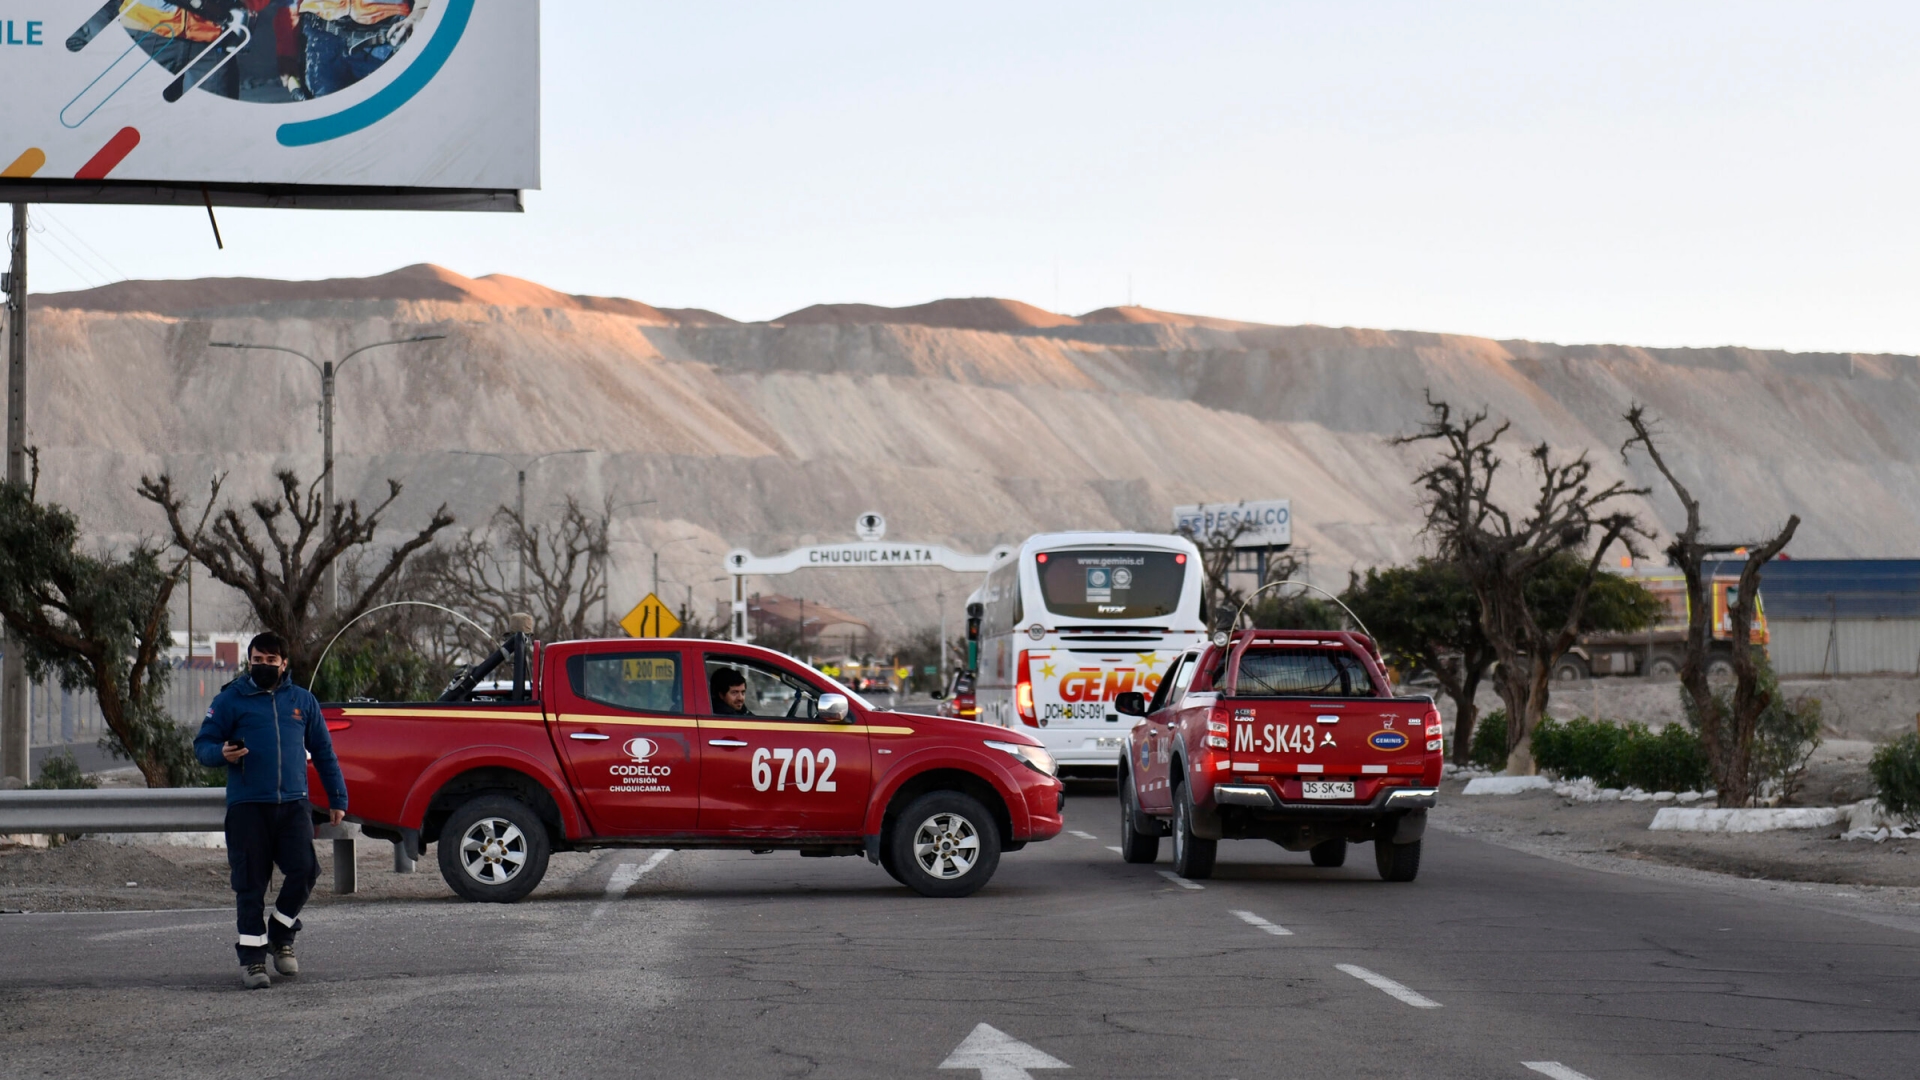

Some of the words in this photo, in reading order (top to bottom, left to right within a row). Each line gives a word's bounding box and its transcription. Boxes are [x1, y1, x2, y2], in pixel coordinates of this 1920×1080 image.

[1205, 508, 1289, 529] BESALCO
[809, 550, 933, 563] CHUQUICAMATA
[1077, 557, 1144, 567] www.geminis.cl
[625, 661, 632, 679] A
[636, 661, 653, 679] 200
[1234, 724, 1315, 753] M-SK43
[609, 765, 671, 776] CODELCO
[752, 748, 837, 792] 6702
